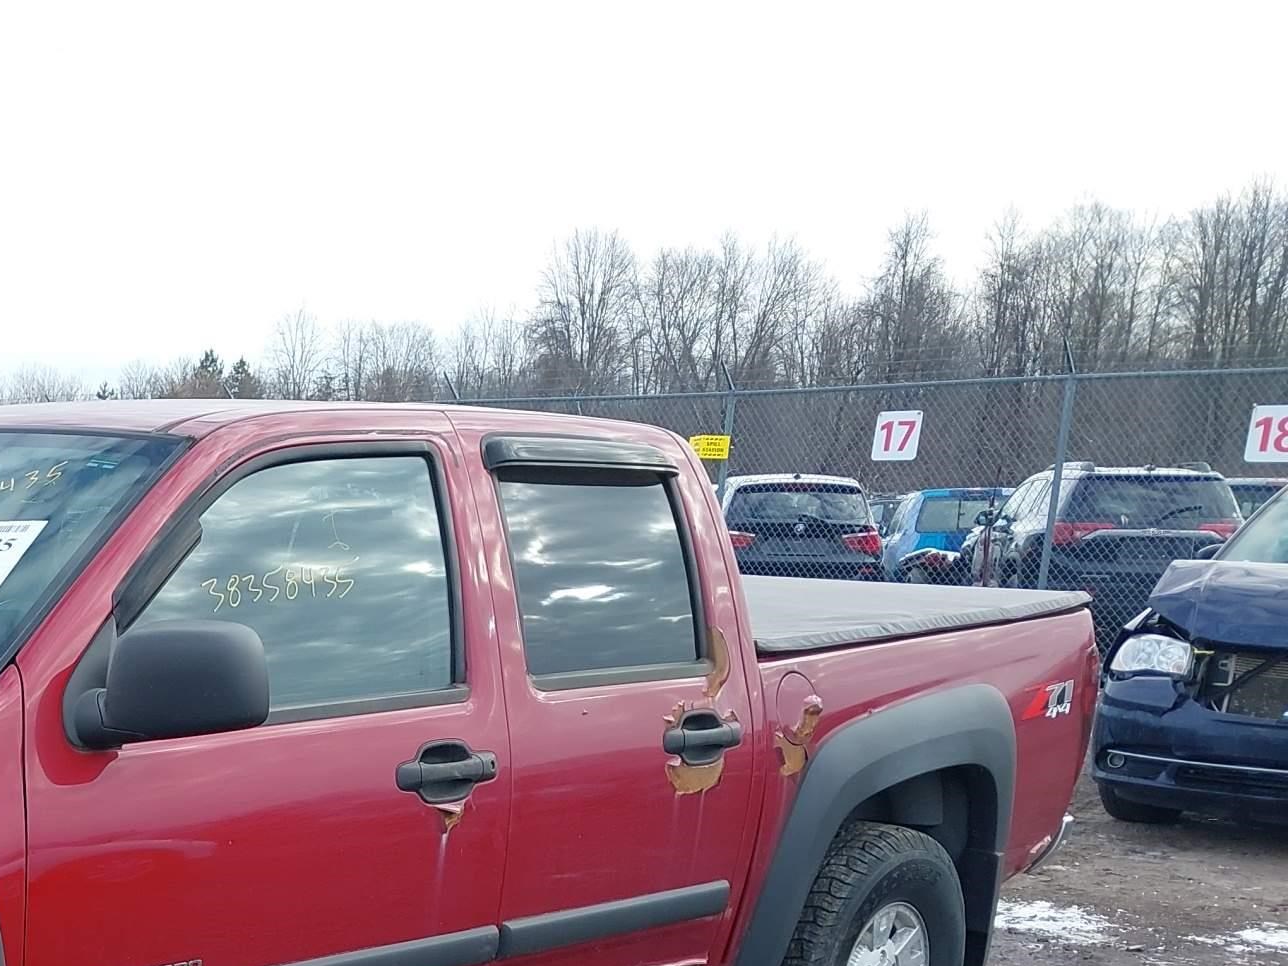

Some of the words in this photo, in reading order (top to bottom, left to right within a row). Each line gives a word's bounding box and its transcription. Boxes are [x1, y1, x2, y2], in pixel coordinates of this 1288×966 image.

[880, 420, 916, 452] 17
[1255, 416, 1288, 452] 18
[200, 556, 360, 613] 38358435
